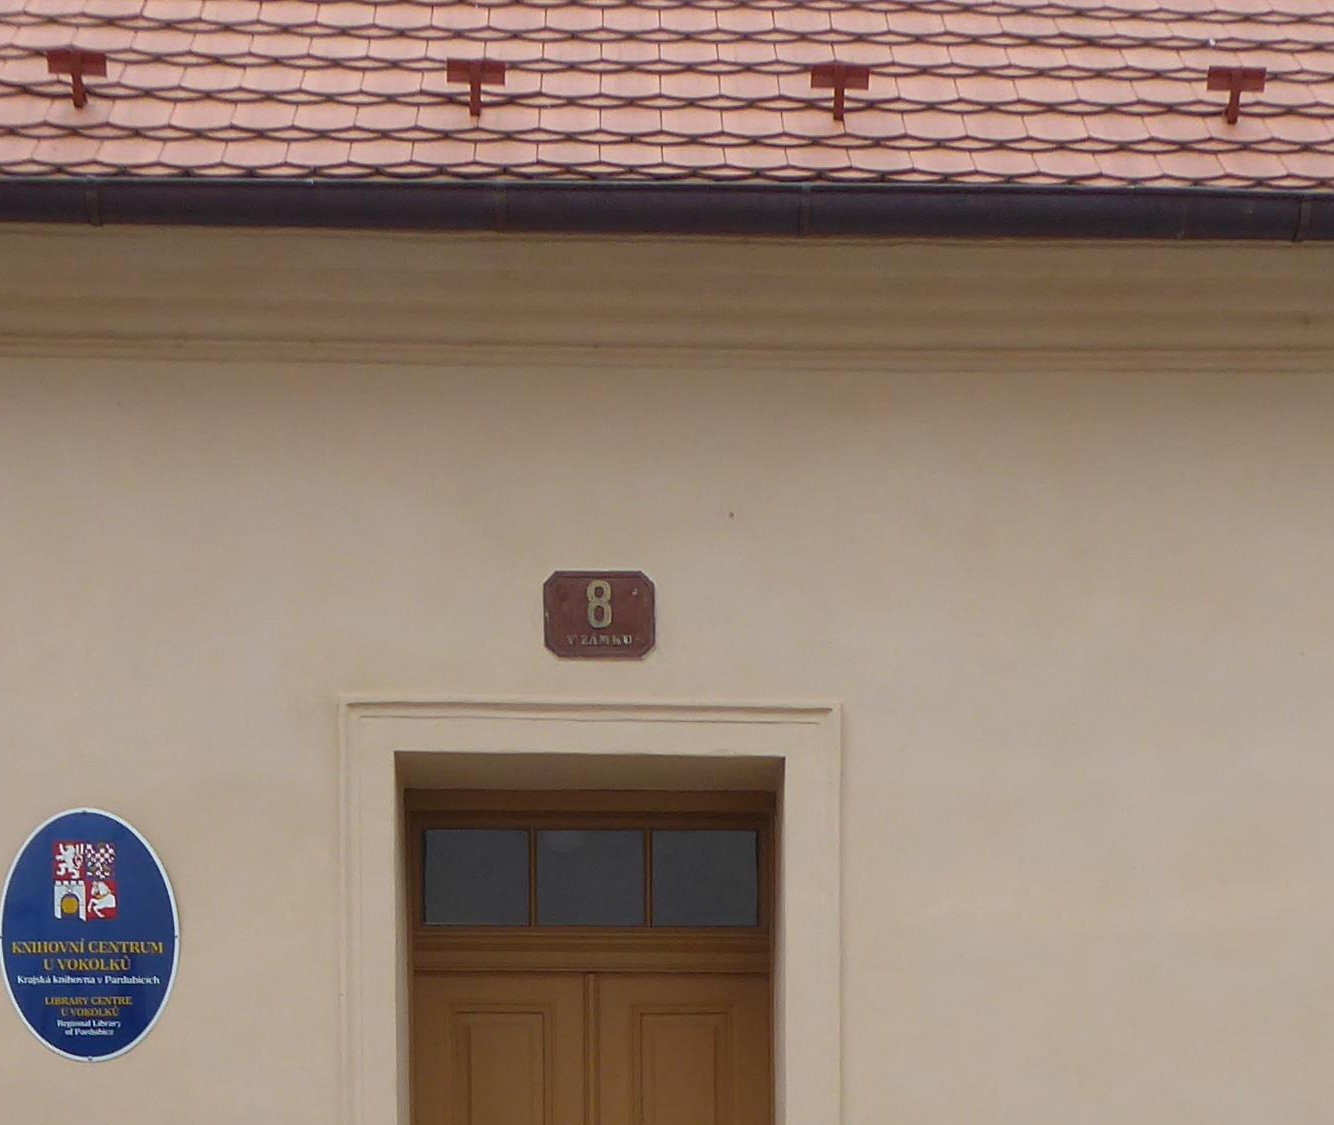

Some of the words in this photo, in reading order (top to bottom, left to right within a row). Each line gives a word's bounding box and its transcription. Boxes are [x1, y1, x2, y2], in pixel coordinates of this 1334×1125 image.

[586, 579, 613, 629] 8
[12, 938, 85, 954] KNIHOVNÍ
[88, 941, 164, 954] CENTRUM
[43, 958, 55, 971] U
[58, 955, 131, 971] VOKOLKŮ
[17, 975, 51, 985] Krajská
[53, 975, 96, 984] knihovna
[44, 996, 88, 1005] LIBRARY
[90, 996, 133, 1005] CENTRE
